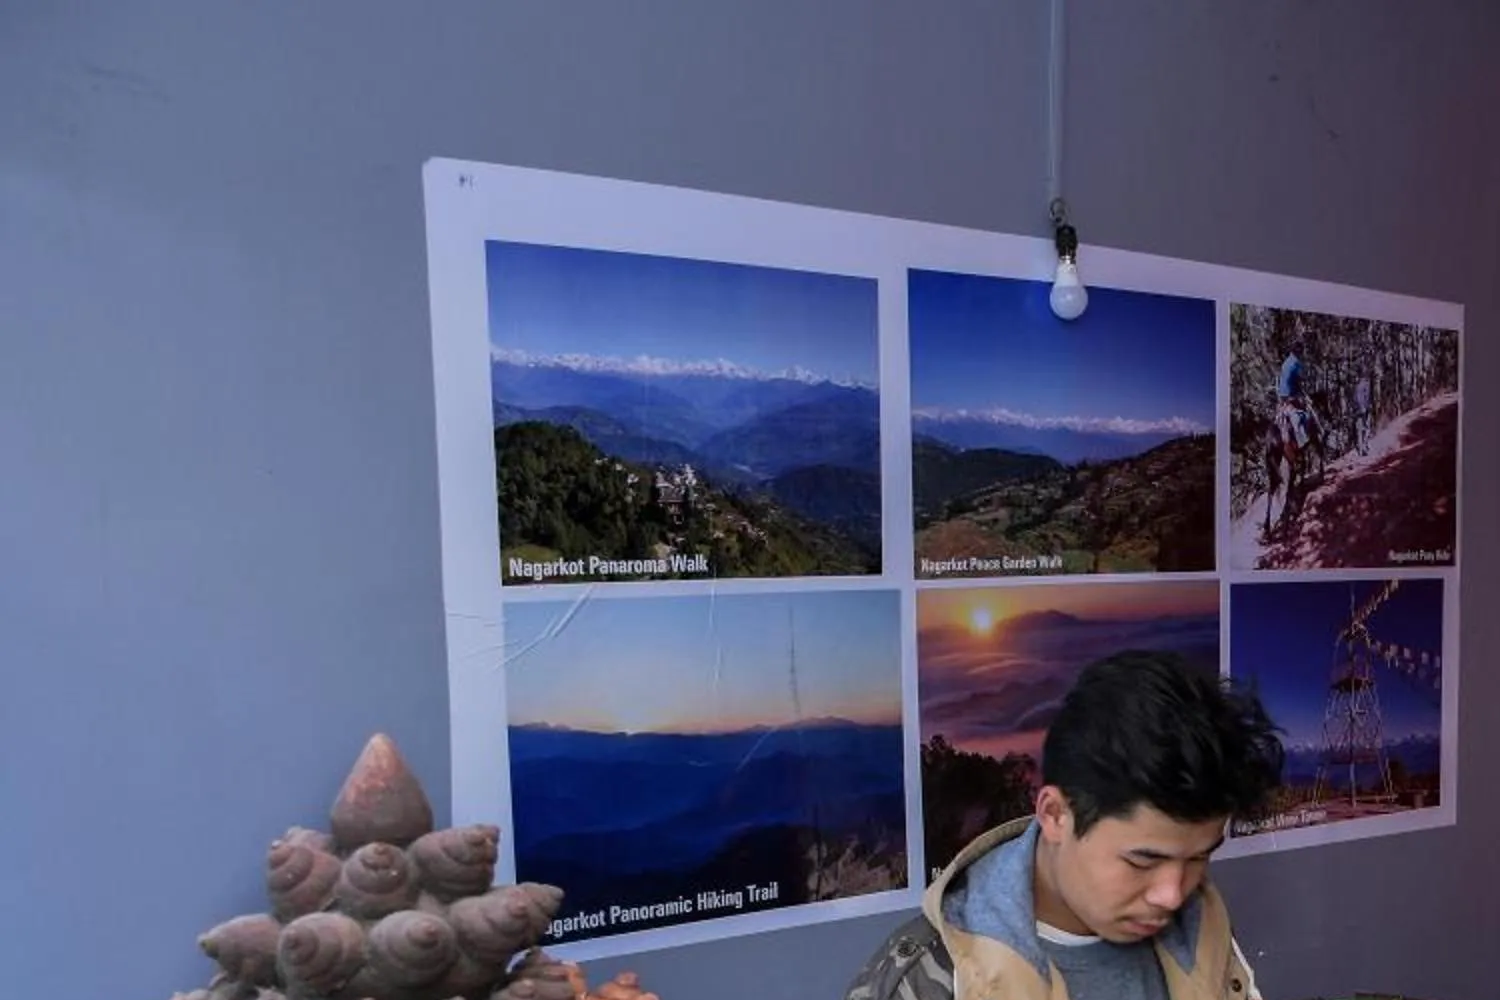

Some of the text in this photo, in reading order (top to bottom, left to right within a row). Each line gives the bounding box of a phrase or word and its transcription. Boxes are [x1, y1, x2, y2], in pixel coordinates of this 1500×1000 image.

[509, 553, 709, 580] Nagarkot Panaroma Walk
[920, 554, 1063, 574] Nagarkot Peace Garden Walk
[545, 881, 779, 938] agarkot Panoramic Hiking Trail
